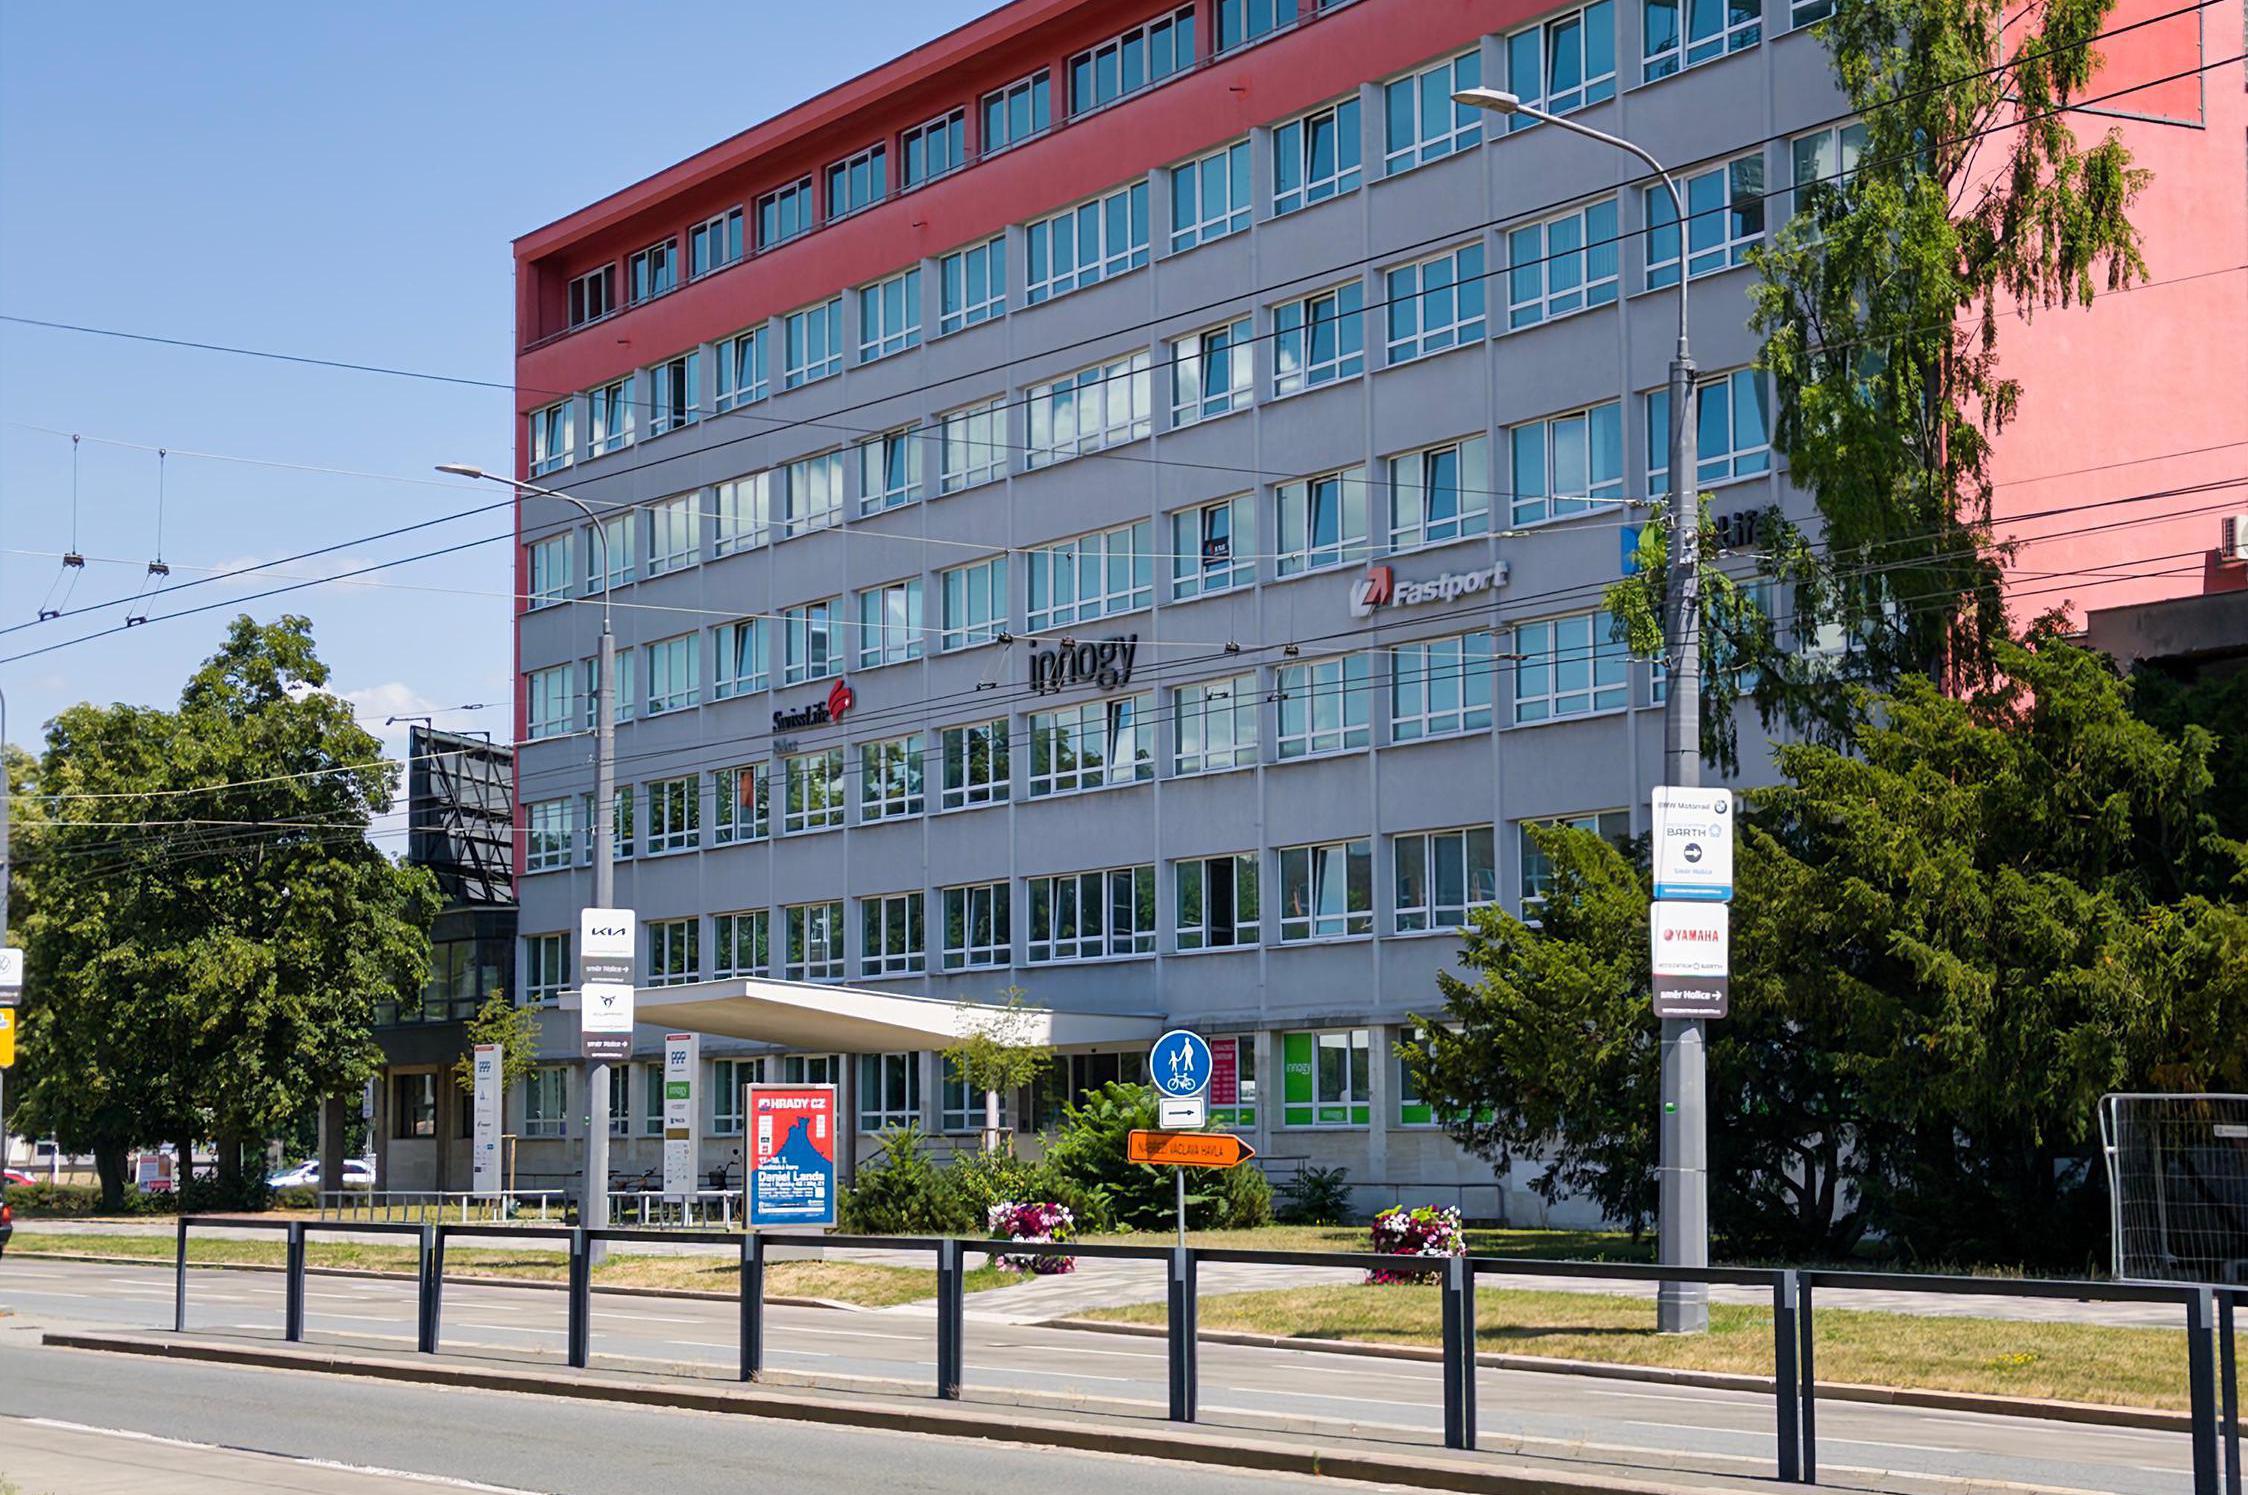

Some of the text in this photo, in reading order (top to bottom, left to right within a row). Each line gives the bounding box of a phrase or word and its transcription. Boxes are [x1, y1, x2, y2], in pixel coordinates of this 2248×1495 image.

[1392, 560, 1508, 607] Fastport
[1029, 633, 1138, 691] innogy
[1666, 827, 1706, 837] BARTH
[591, 927, 626, 936] KIA
[1675, 929, 1719, 942] YAMAHA
[1286, 1063, 1311, 1075] innogy
[770, 1098, 826, 1109] HRADY CZ
[758, 1171, 825, 1181] Daniel Landa
